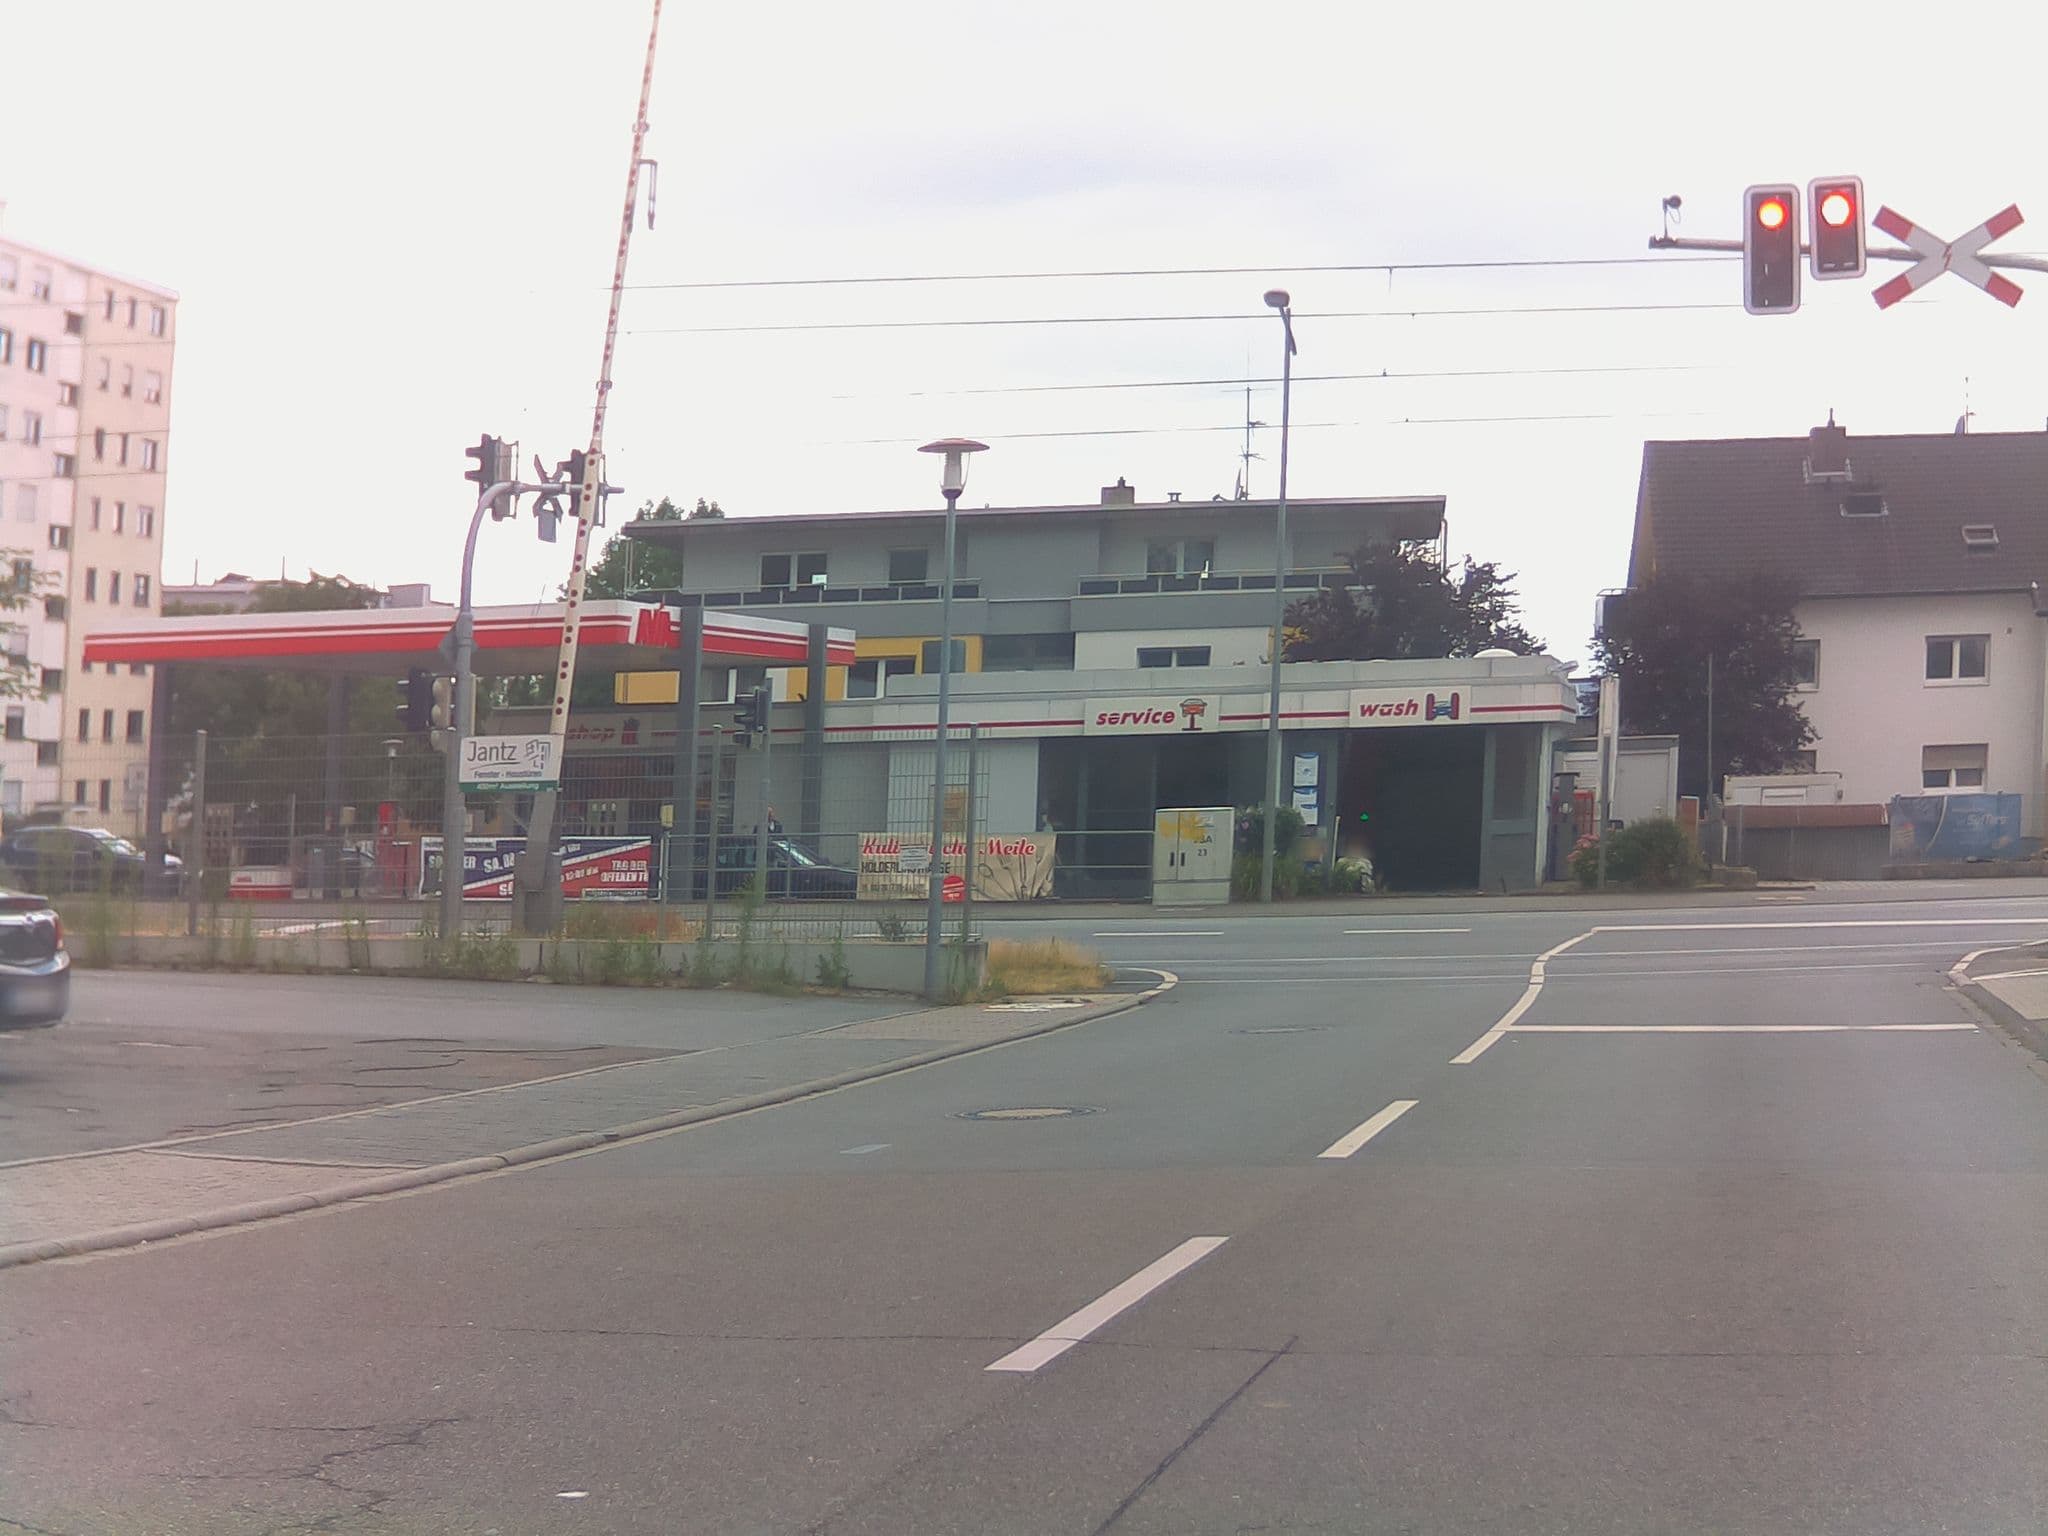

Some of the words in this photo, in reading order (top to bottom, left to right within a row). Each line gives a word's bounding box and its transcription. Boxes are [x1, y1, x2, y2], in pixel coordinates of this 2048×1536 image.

[1095, 707, 1176, 726] service
[1359, 698, 1419, 718] wash
[566, 723, 616, 742] shop
[467, 741, 518, 762] Jantz
[979, 837, 1036, 856] Meile
